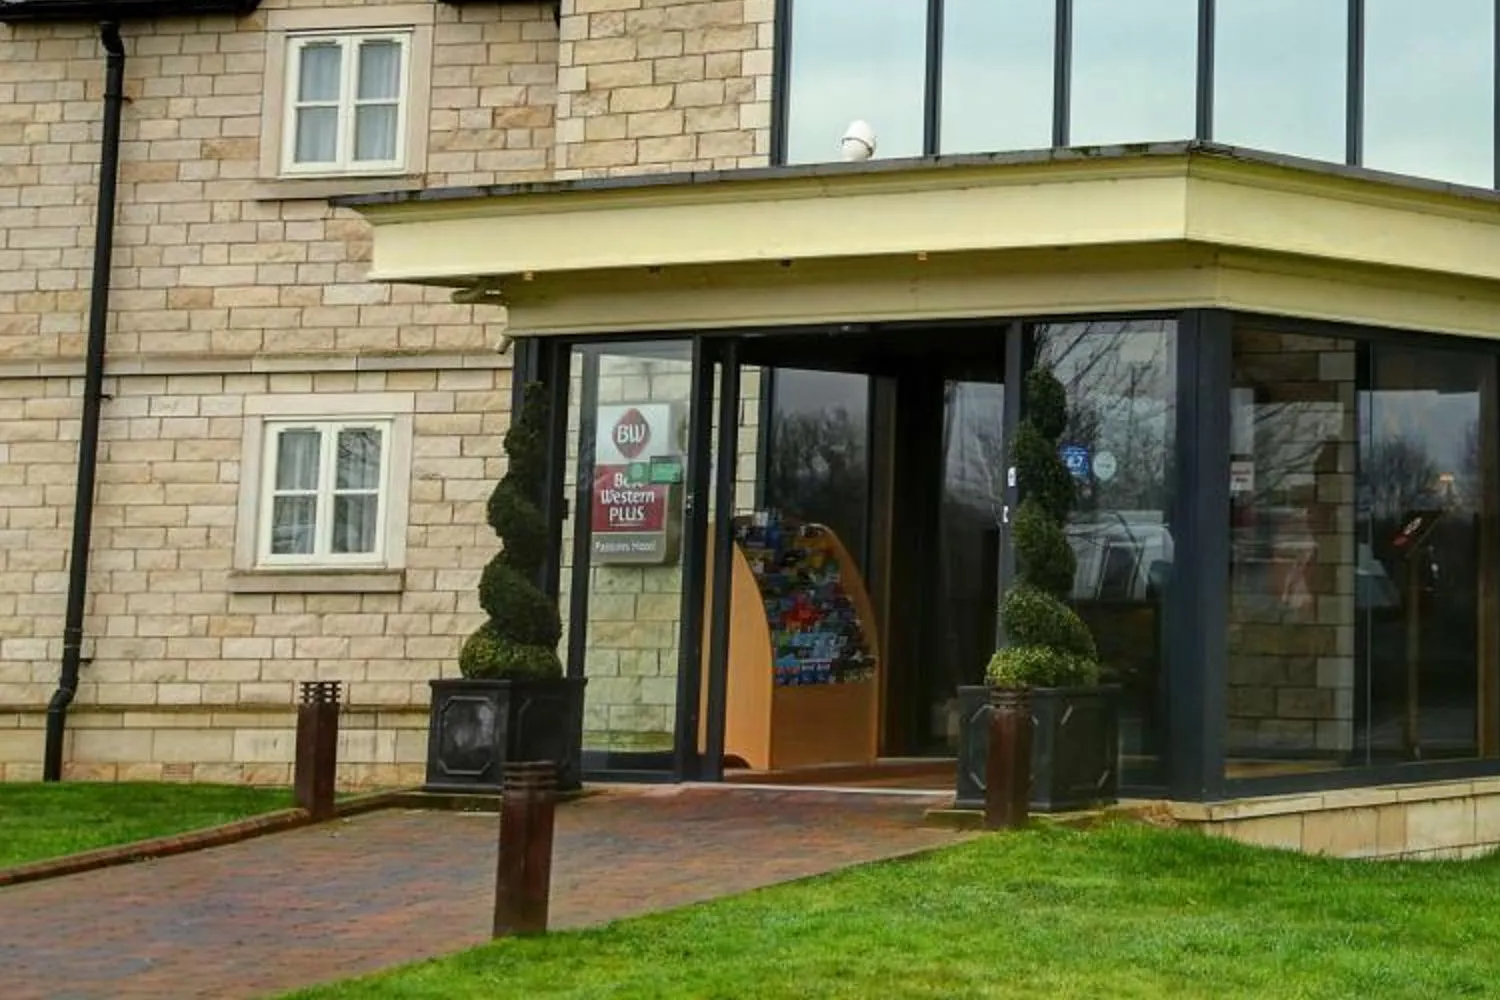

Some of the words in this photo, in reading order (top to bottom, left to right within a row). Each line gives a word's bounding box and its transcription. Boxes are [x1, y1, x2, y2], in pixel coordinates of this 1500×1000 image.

[617, 424, 645, 443] BW
[601, 489, 654, 504] Western
[609, 506, 644, 522] PLUS
